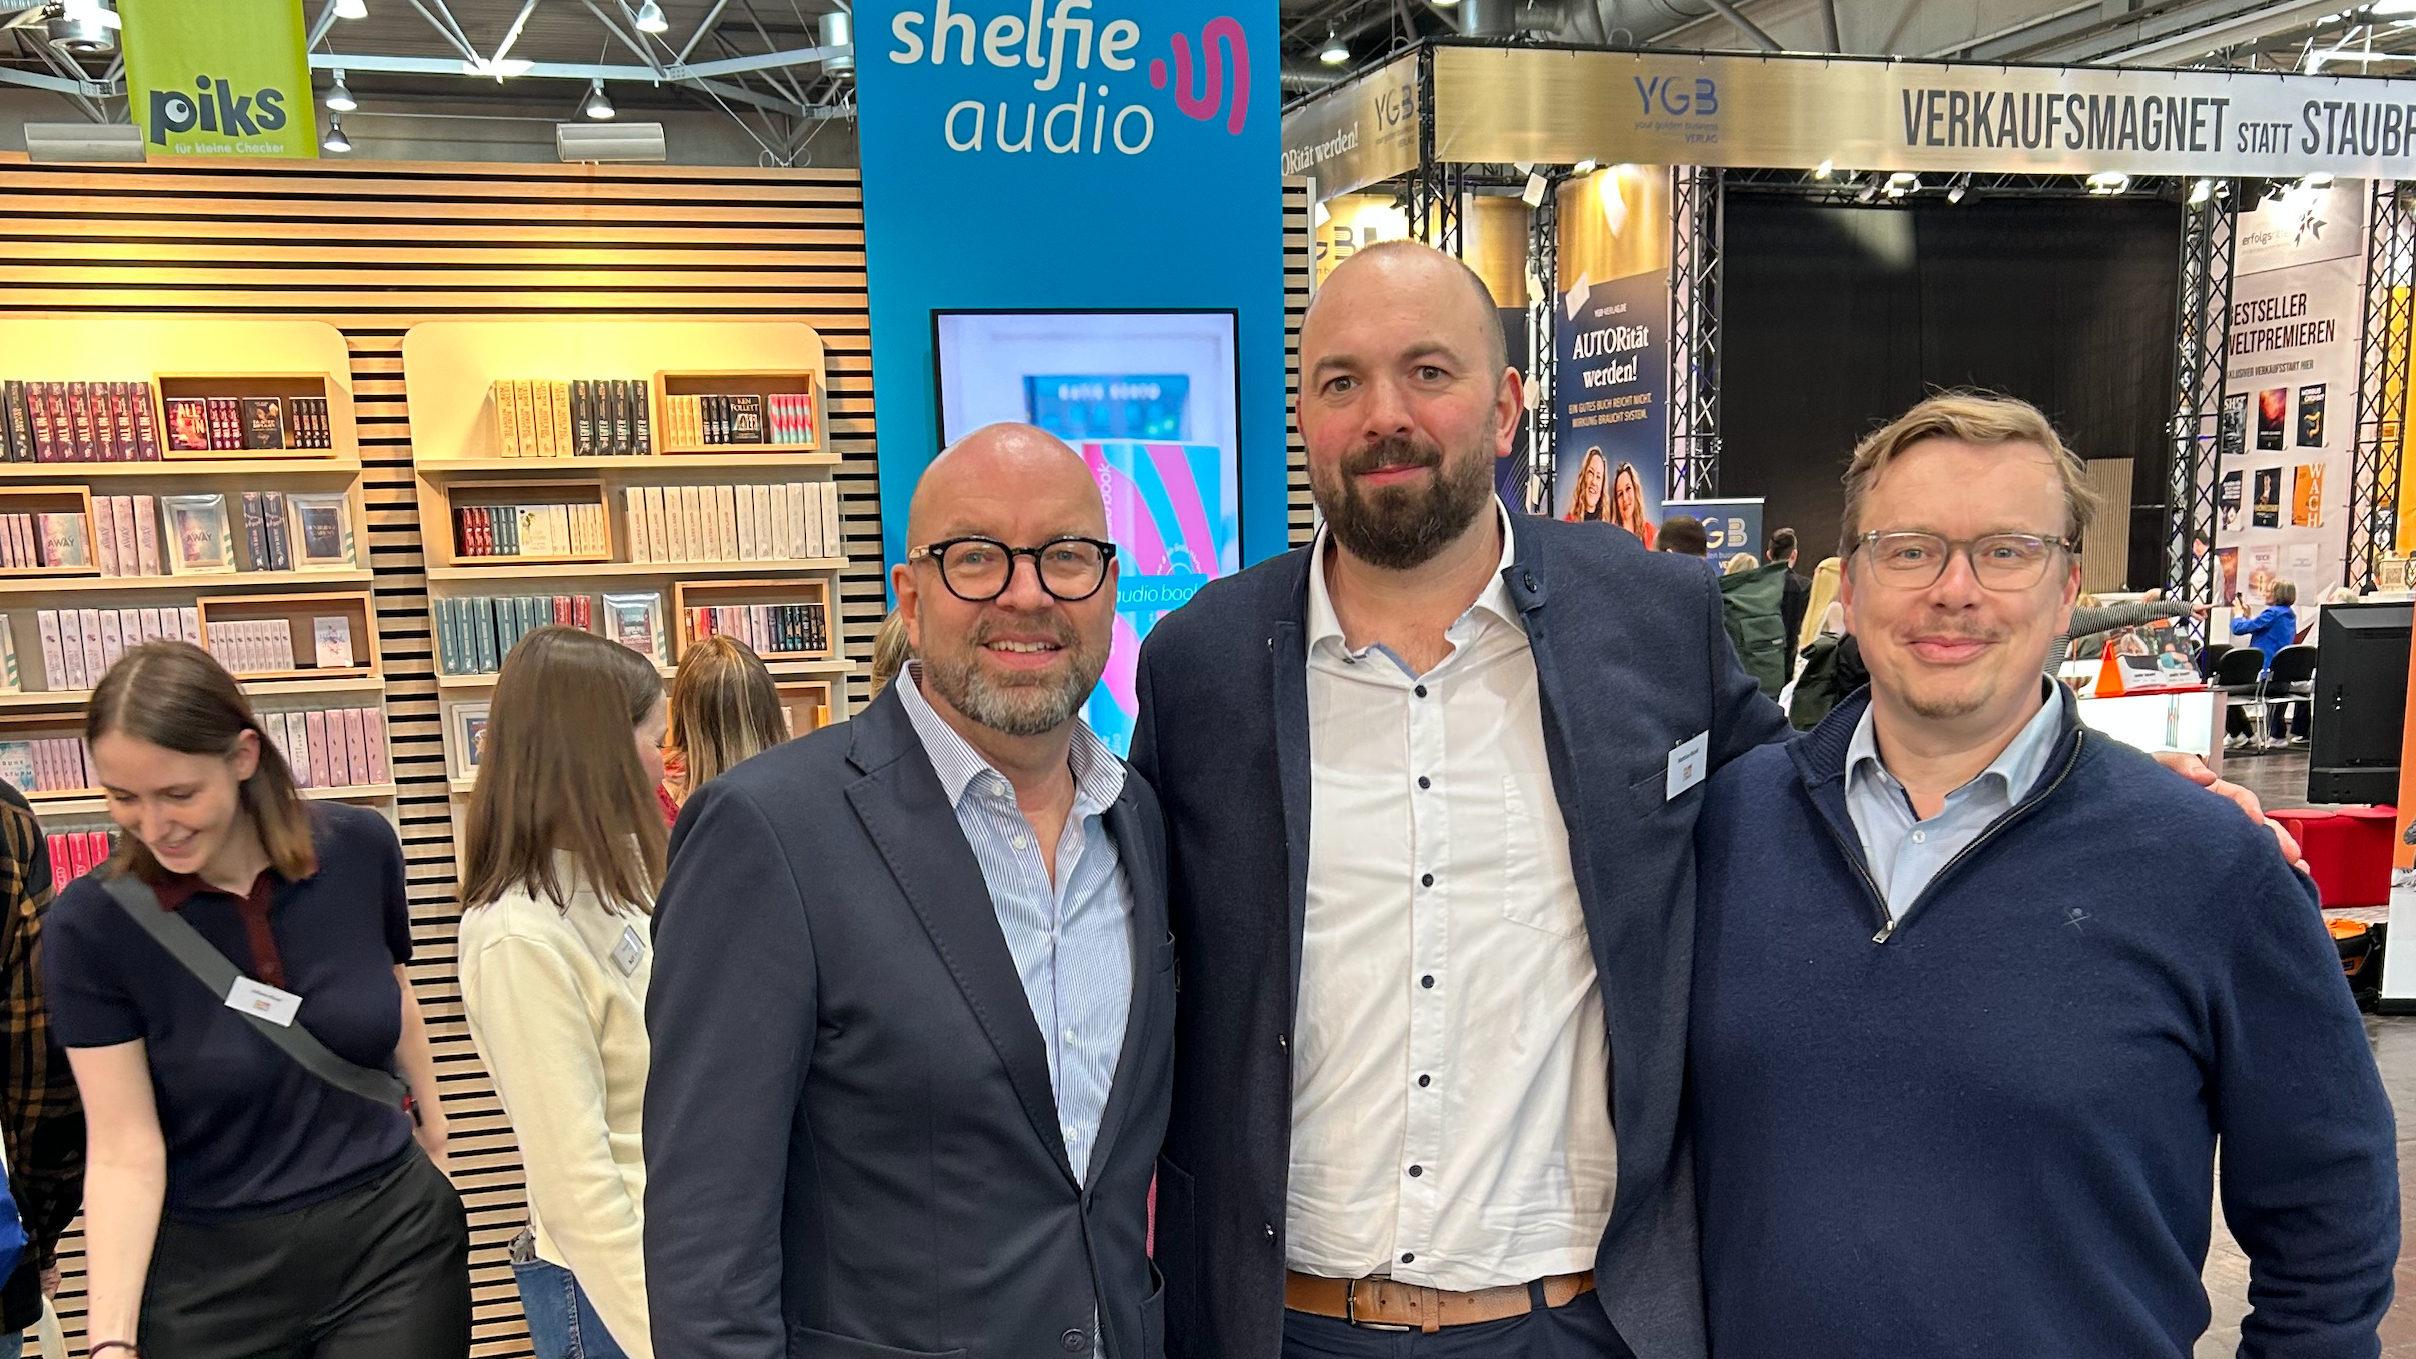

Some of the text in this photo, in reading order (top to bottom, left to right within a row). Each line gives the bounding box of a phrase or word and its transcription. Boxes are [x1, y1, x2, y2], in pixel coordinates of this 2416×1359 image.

[888, 0, 1141, 91] shelfie
[149, 74, 287, 146] piks
[1374, 84, 1415, 131] YGB
[1634, 76, 1719, 116] YGB
[944, 82, 1154, 155] audio
[1902, 88, 2230, 152] VERKAUFSMAGNET
[2238, 122, 2293, 154] STATT
[175, 142, 285, 154] für kleine Checker
[1315, 121, 1359, 163] werden!
[1685, 134, 1718, 143] VERLAG
[1572, 324, 1649, 360] AUTORität
[1583, 354, 1638, 388] werden!
[177, 403, 200, 418] ALL
[730, 404, 760, 412] FOLLETT
[192, 419, 206, 434] IN
[1097, 463, 1112, 506] book
[48, 536, 74, 548] AWAY
[186, 532, 212, 542] AWAY
[1697, 517, 1748, 549] GB
